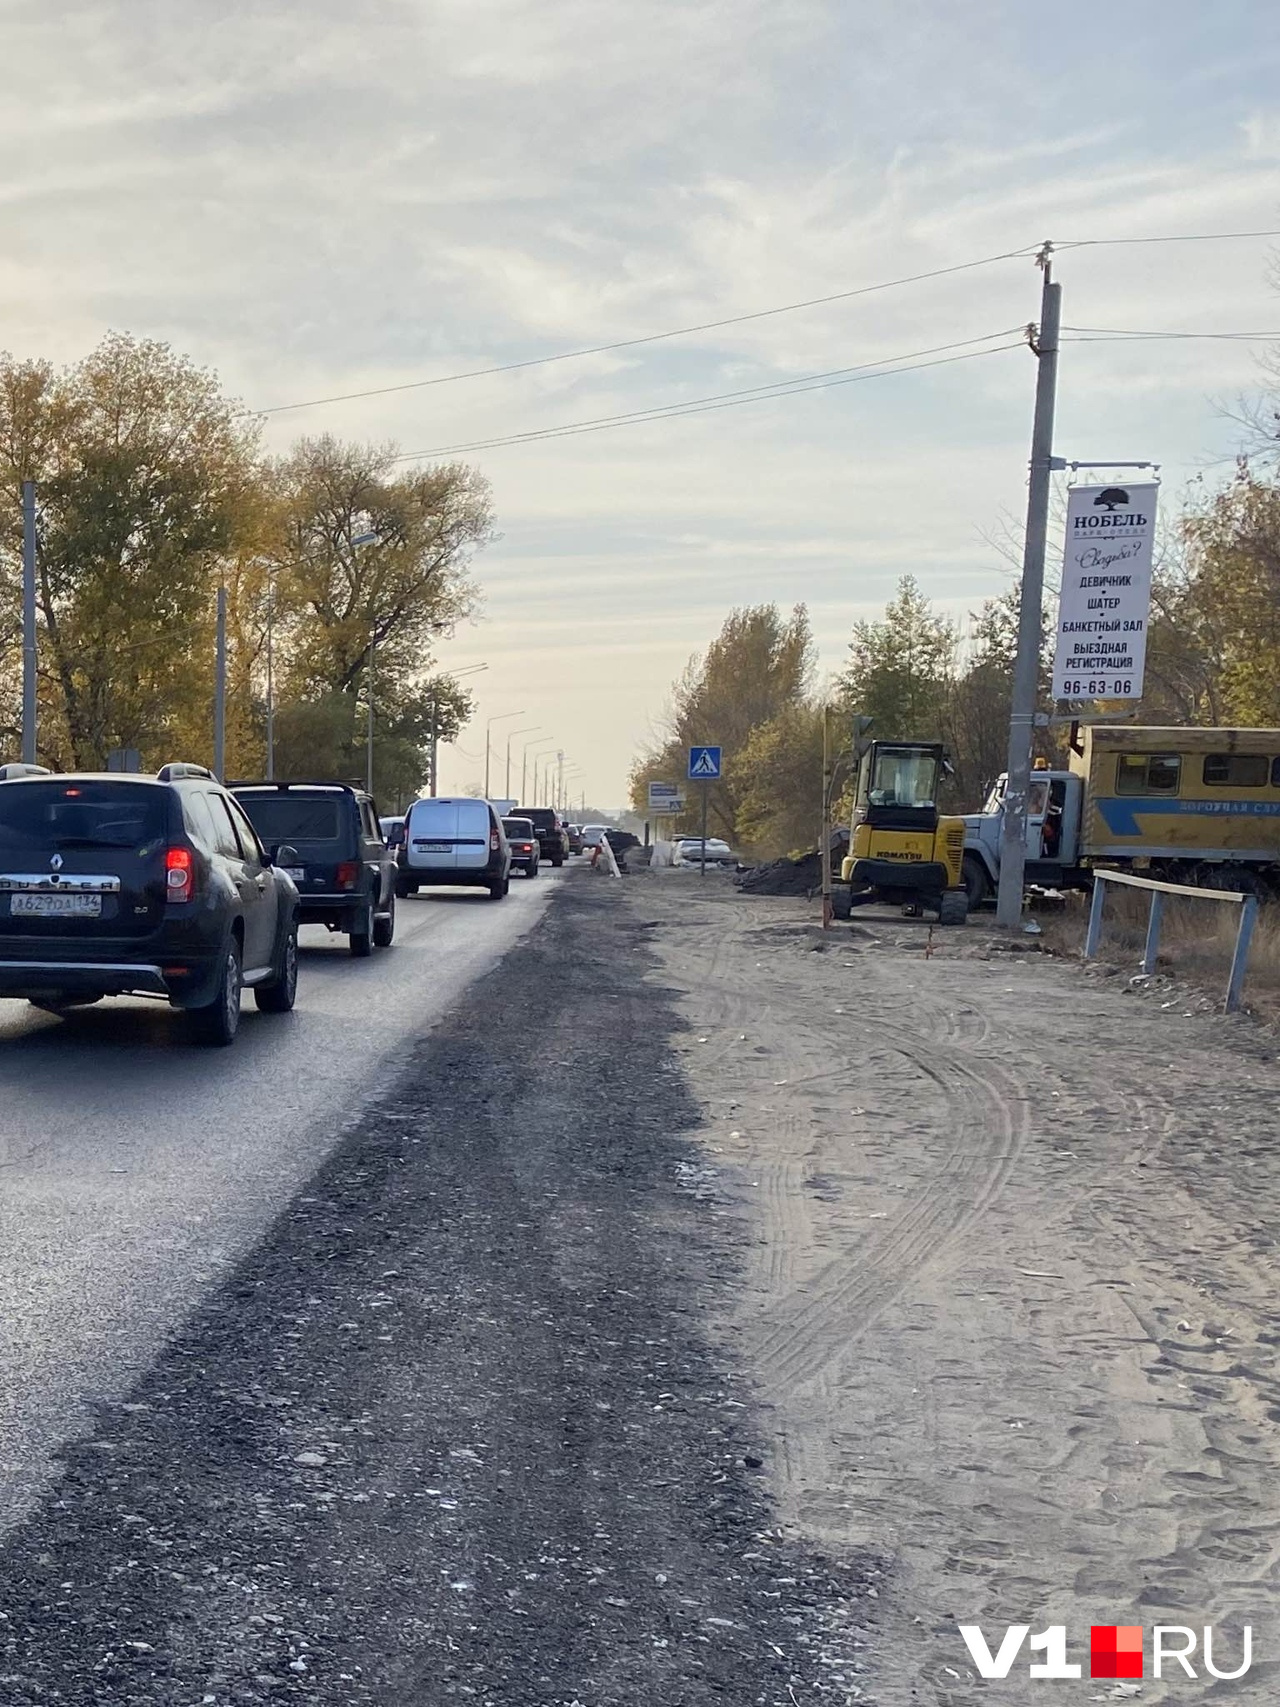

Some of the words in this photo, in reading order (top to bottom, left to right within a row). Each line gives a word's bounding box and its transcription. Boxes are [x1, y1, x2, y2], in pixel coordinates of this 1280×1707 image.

[1074, 514, 1147, 529] НОБЕЛЬ
[1080, 575, 1132, 588] ДЕВИЧНИК
[1087, 598, 1120, 609] ШАТЕР
[1062, 619, 1121, 632] БАНКЕТНЫЙ
[1123, 620, 1143, 631] ЗАЛ
[1074, 643, 1128, 654] ВЫЕЗДНАЯ
[1066, 657, 1133, 668] РЕГИСТРАЦИЯ
[1063, 680, 1132, 694] 96-63-06
[876, 851, 923, 860] KOMATSU
